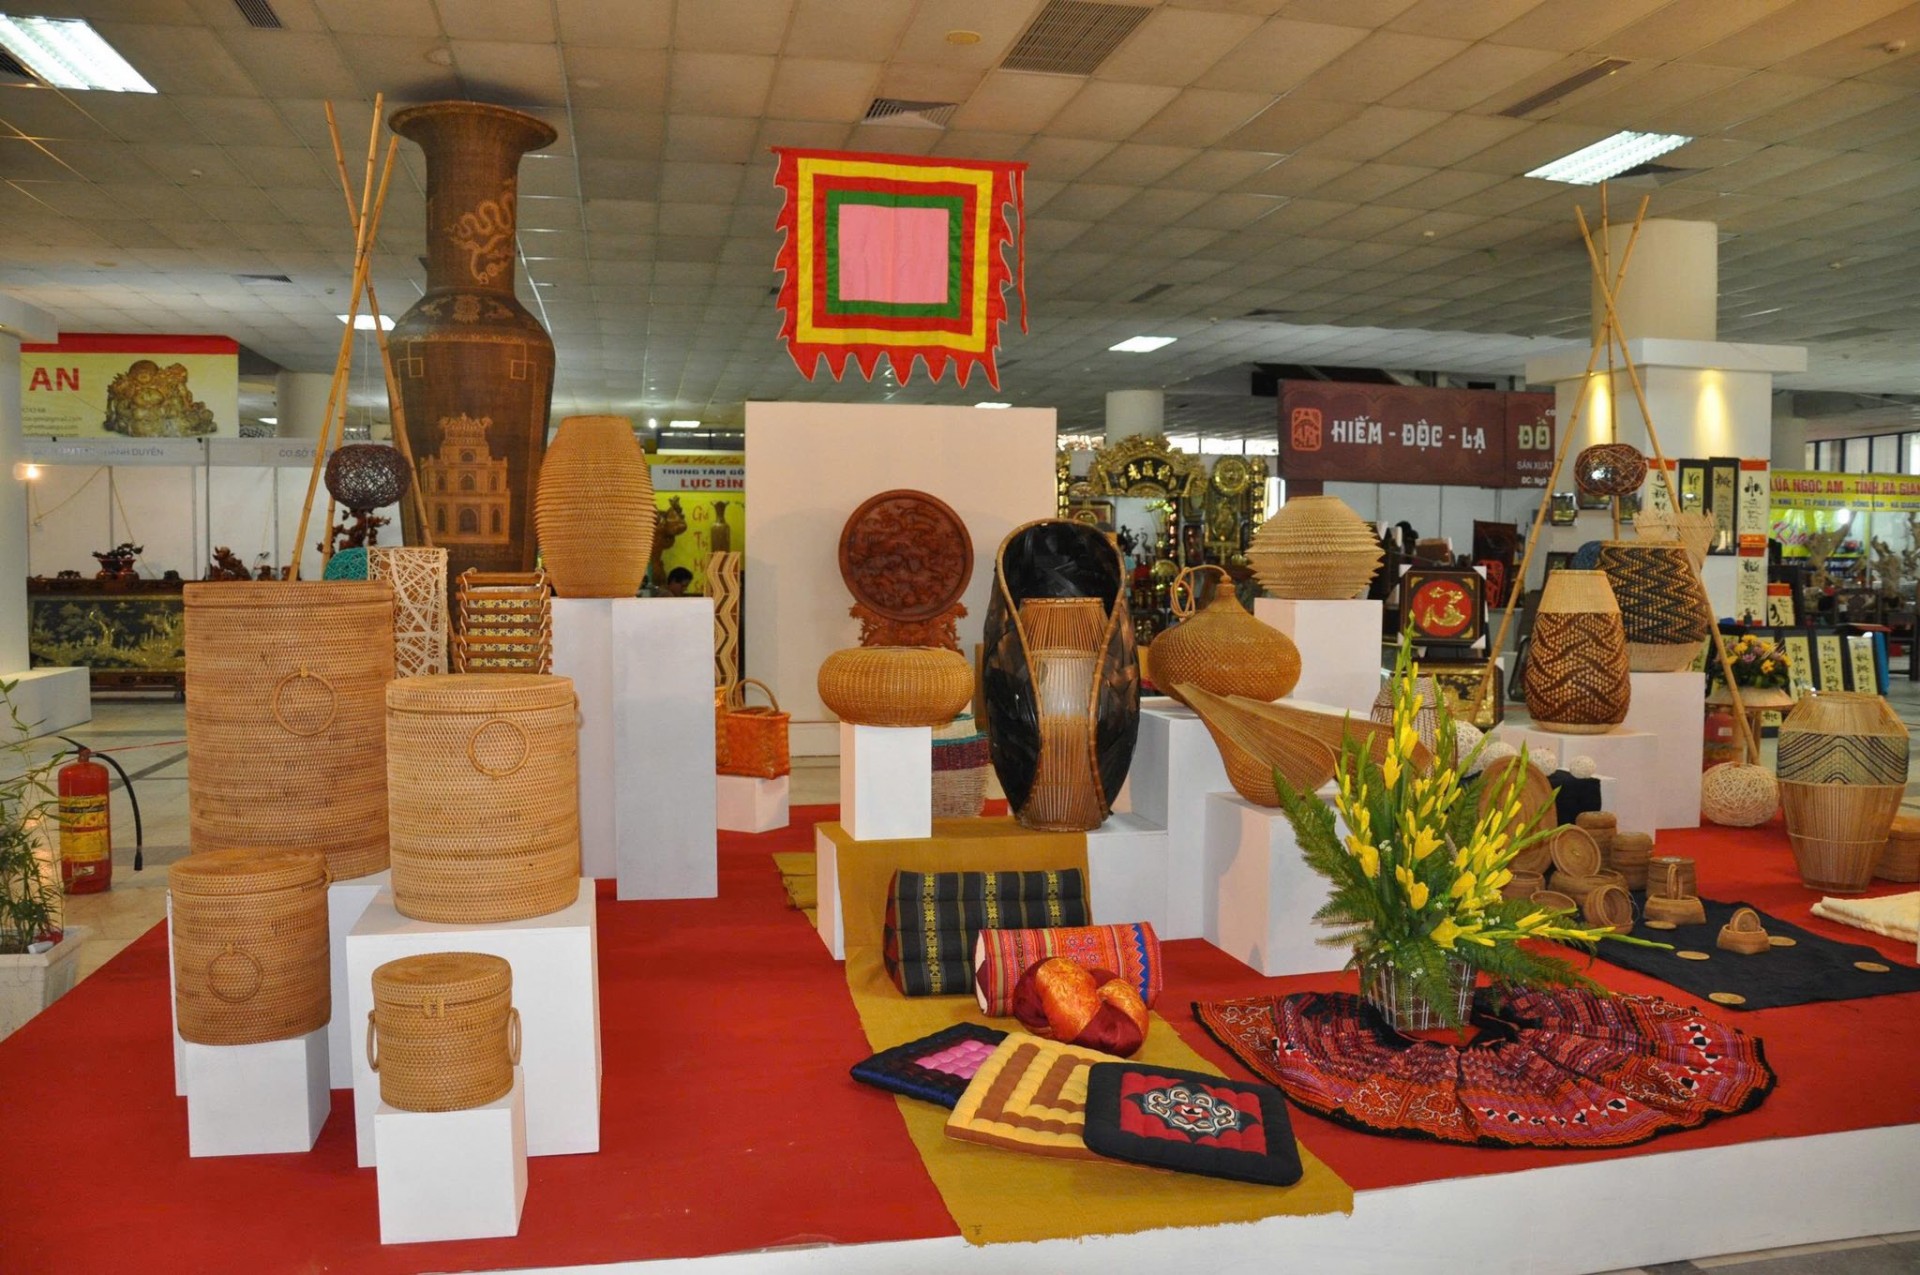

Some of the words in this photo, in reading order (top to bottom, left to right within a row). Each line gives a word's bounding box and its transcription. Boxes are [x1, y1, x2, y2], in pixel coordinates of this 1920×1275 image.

[28, 367, 80, 391] AN
[1330, 416, 1382, 445] HIẾM
[1401, 418, 1443, 452] ĐỘC
[1461, 426, 1486, 454] LẠ
[1518, 416, 1551, 450] ĐỒ
[680, 479, 712, 489] LỤC
